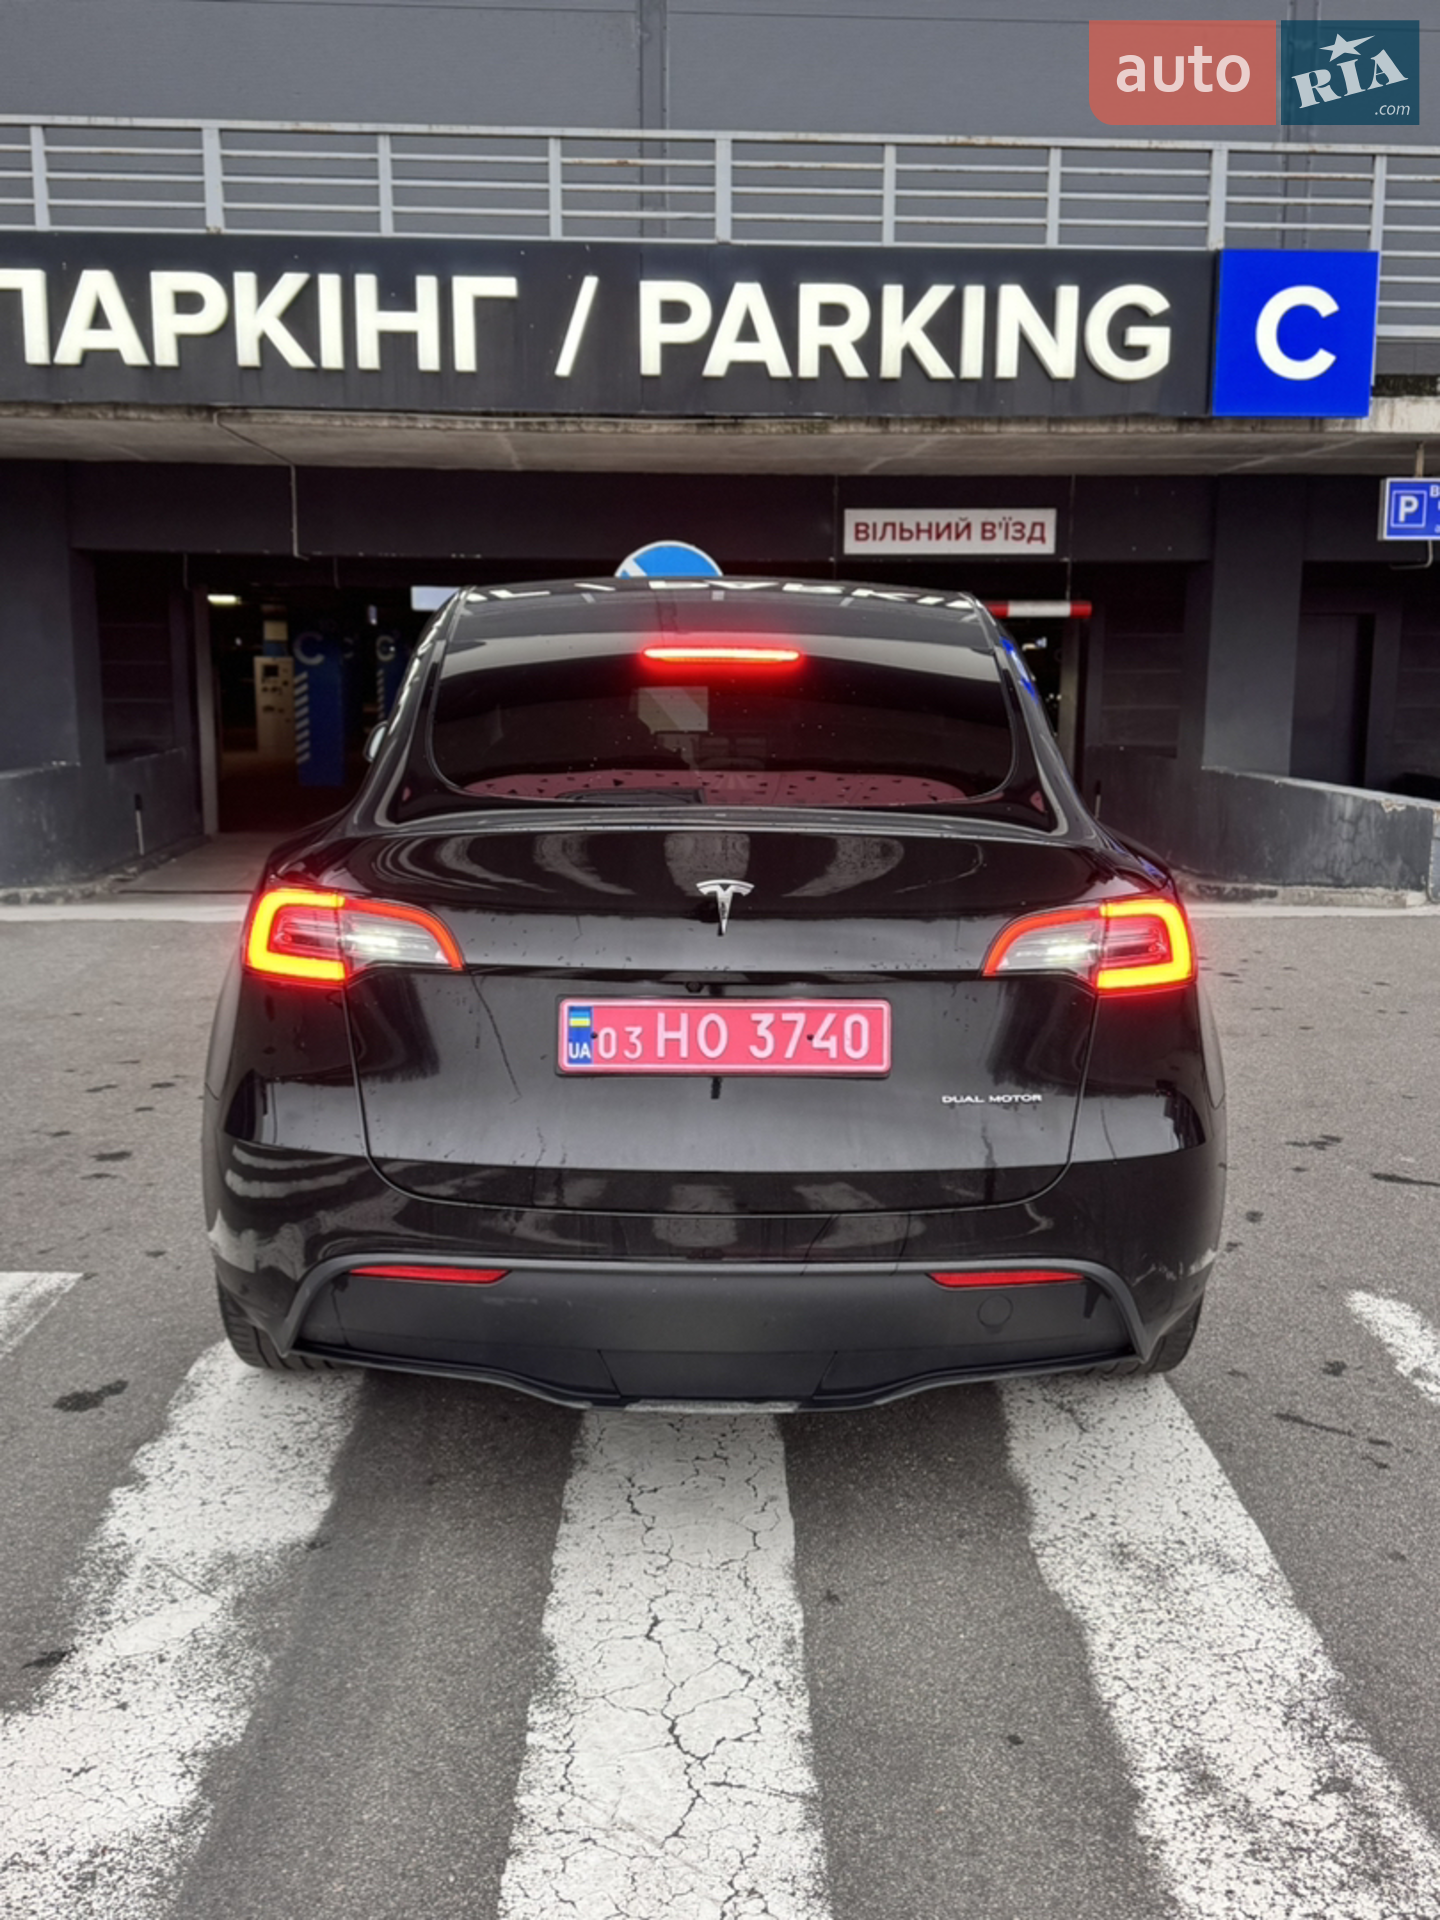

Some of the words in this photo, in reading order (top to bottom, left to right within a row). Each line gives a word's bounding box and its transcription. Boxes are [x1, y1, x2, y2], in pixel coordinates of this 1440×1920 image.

[639, 280, 1172, 382] PARKING
[1255, 285, 1341, 381] C
[1399, 495, 1419, 523] P
[854, 516, 971, 542] ВІЛЬНИЙ
[980, 516, 1046, 544] В'ЇЗД
[568, 1042, 592, 1059] UA
[749, 1013, 871, 1060] 3740
[941, 1094, 985, 1104] DUAL
[988, 1094, 1043, 1103] MOTOR
